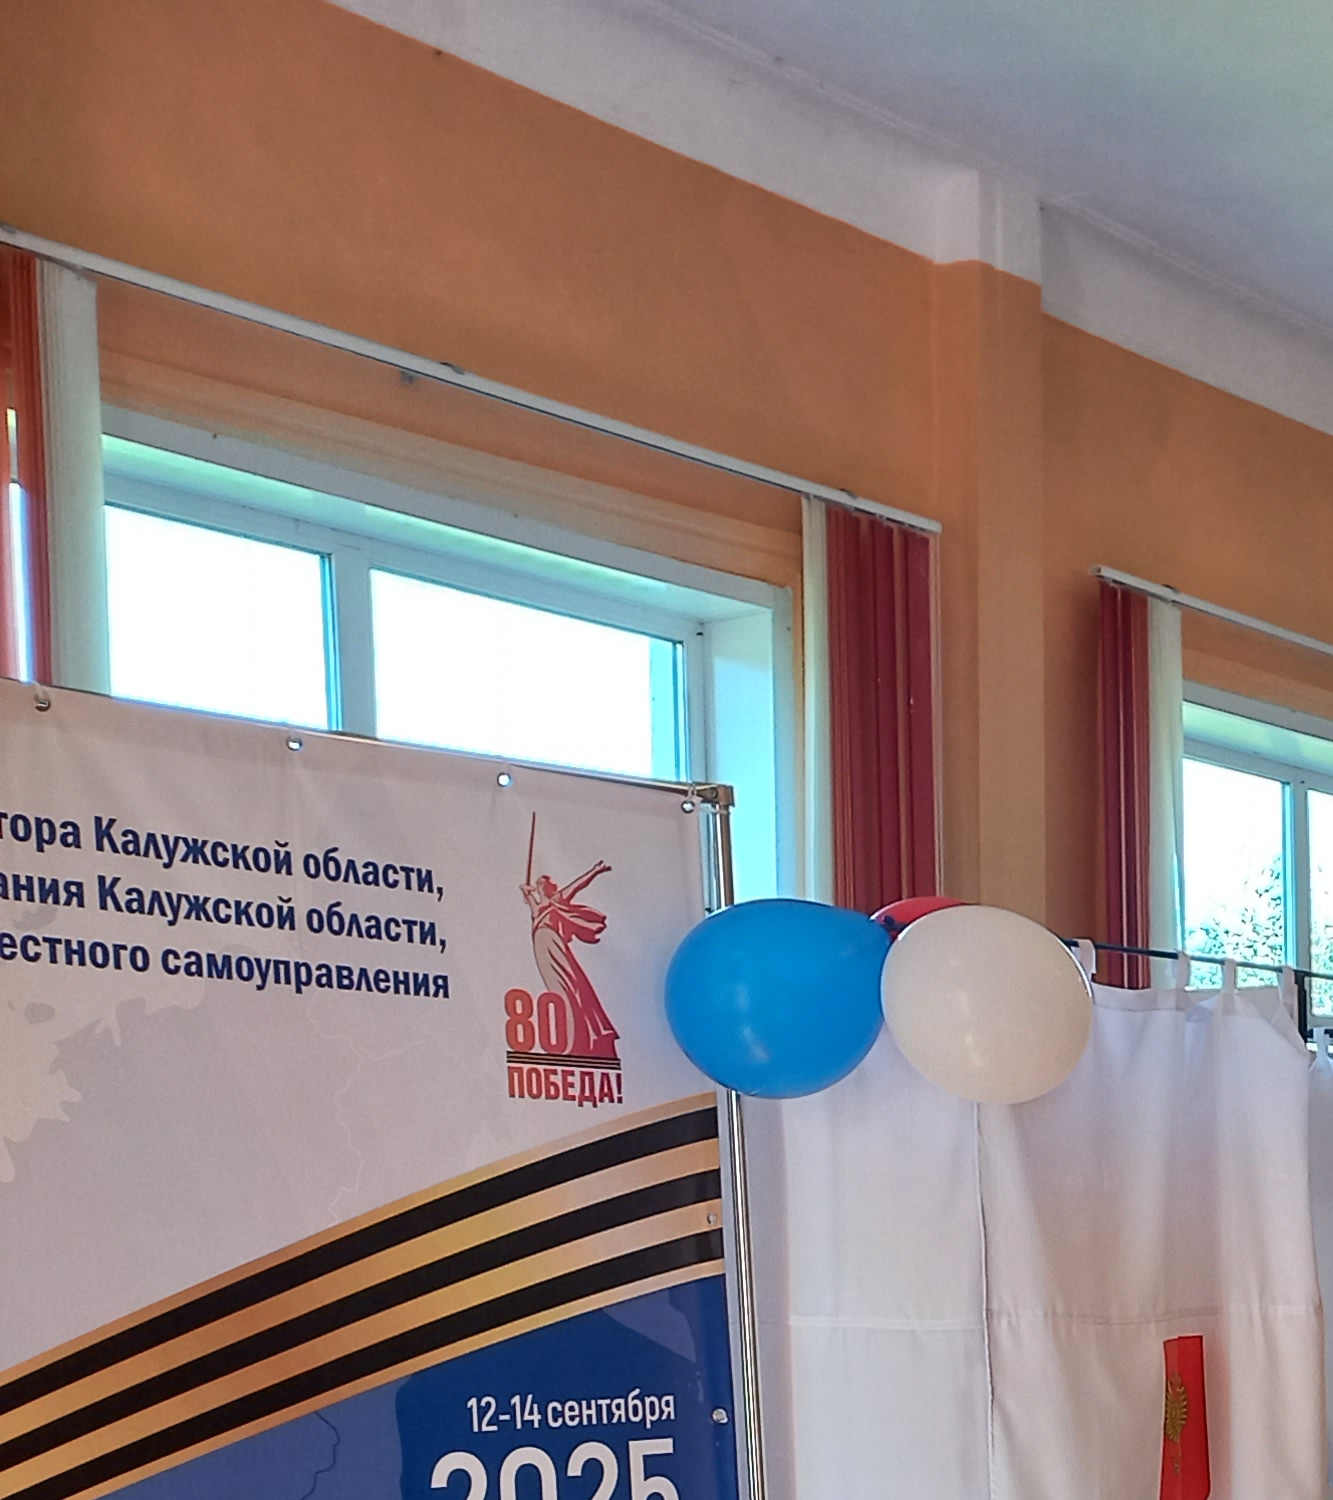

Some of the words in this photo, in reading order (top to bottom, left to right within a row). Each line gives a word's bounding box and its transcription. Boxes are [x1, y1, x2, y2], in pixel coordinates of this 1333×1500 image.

[94, 815, 293, 876] Калужской
[303, 847, 443, 902] области,
[97, 874, 296, 931] Калужской
[306, 901, 446, 954] области,
[161, 948, 450, 999] самоуправления
[505, 989, 568, 1055] 80
[507, 1066, 623, 1108] ПОБЕДА!
[467, 1394, 541, 1432] 12-14
[547, 1388, 676, 1429] сентября
